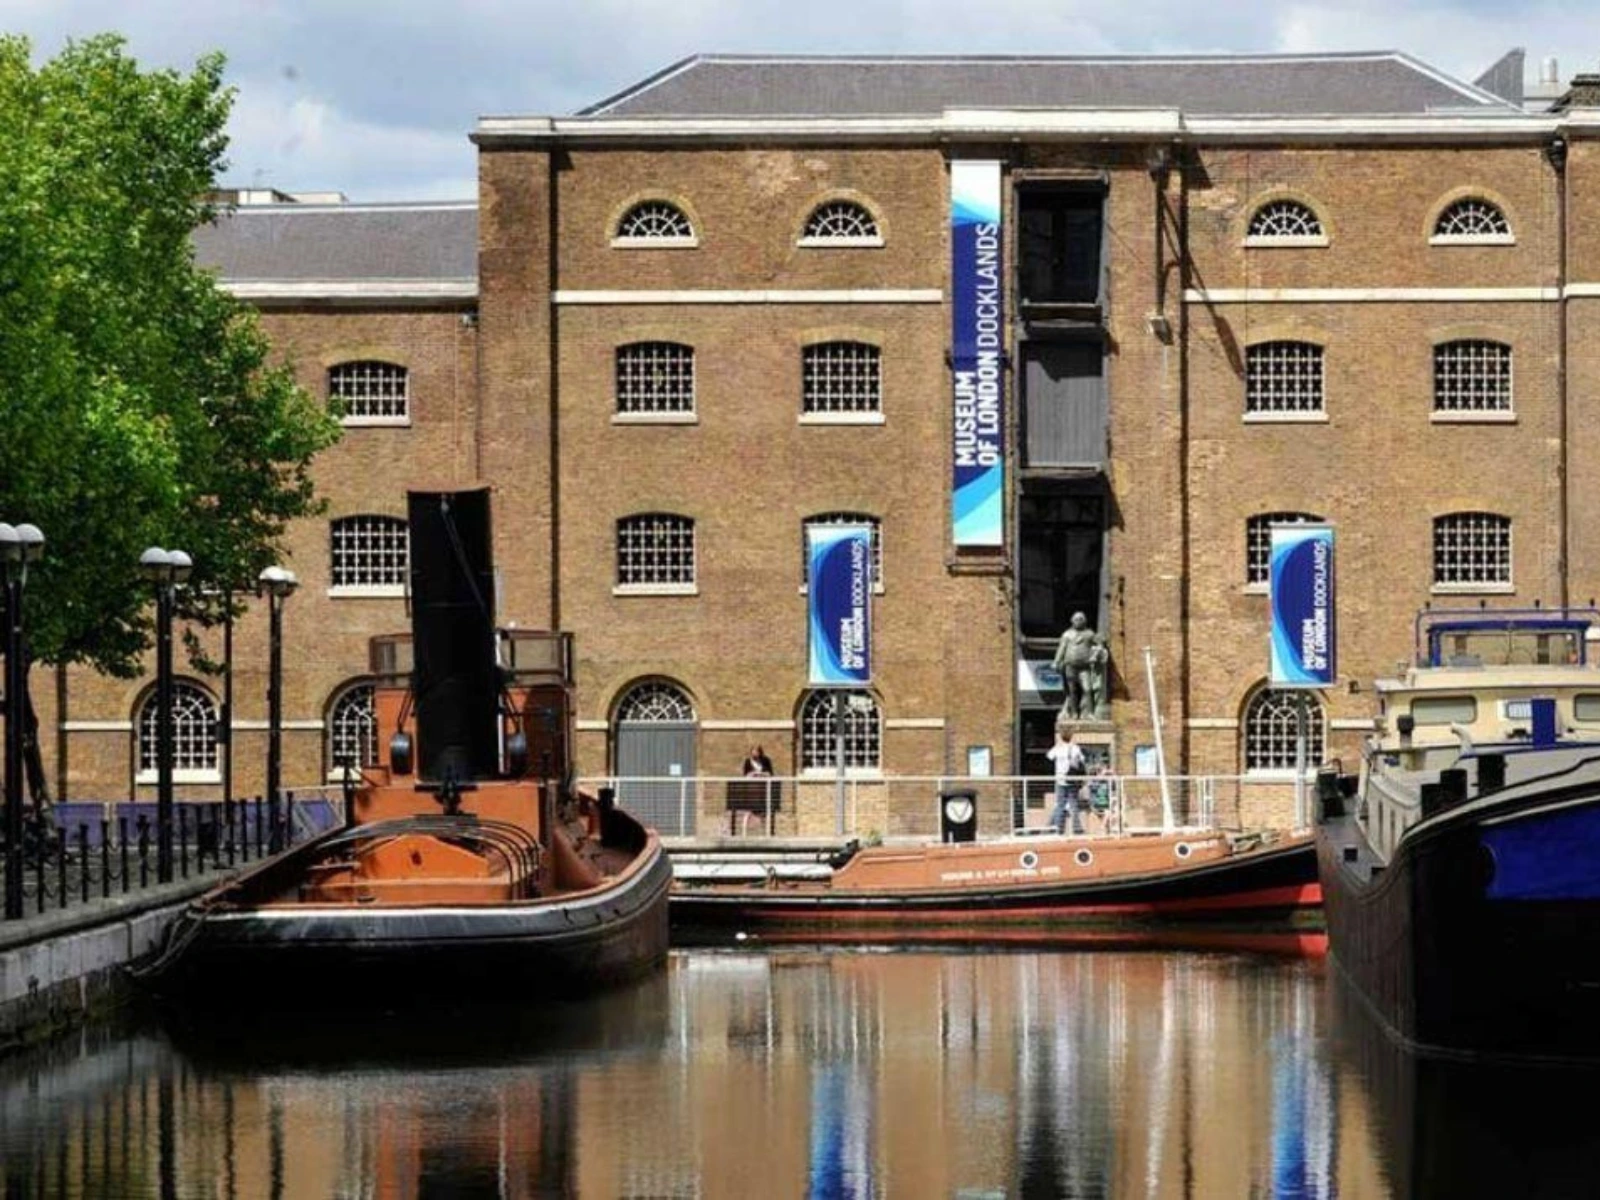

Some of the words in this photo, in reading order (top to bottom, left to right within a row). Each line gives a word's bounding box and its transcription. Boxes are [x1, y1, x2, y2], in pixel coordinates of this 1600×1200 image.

[976, 222, 998, 347] DOCKLANDS
[954, 370, 977, 467] MUSEUM
[977, 350, 999, 435] LONDON
[977, 439, 1000, 466] OF
[1314, 540, 1327, 606] DOCKLANDS
[840, 617, 852, 669] MUSEUM
[1302, 618, 1315, 670] MUSEUM
[1314, 608, 1327, 653] LONDON
